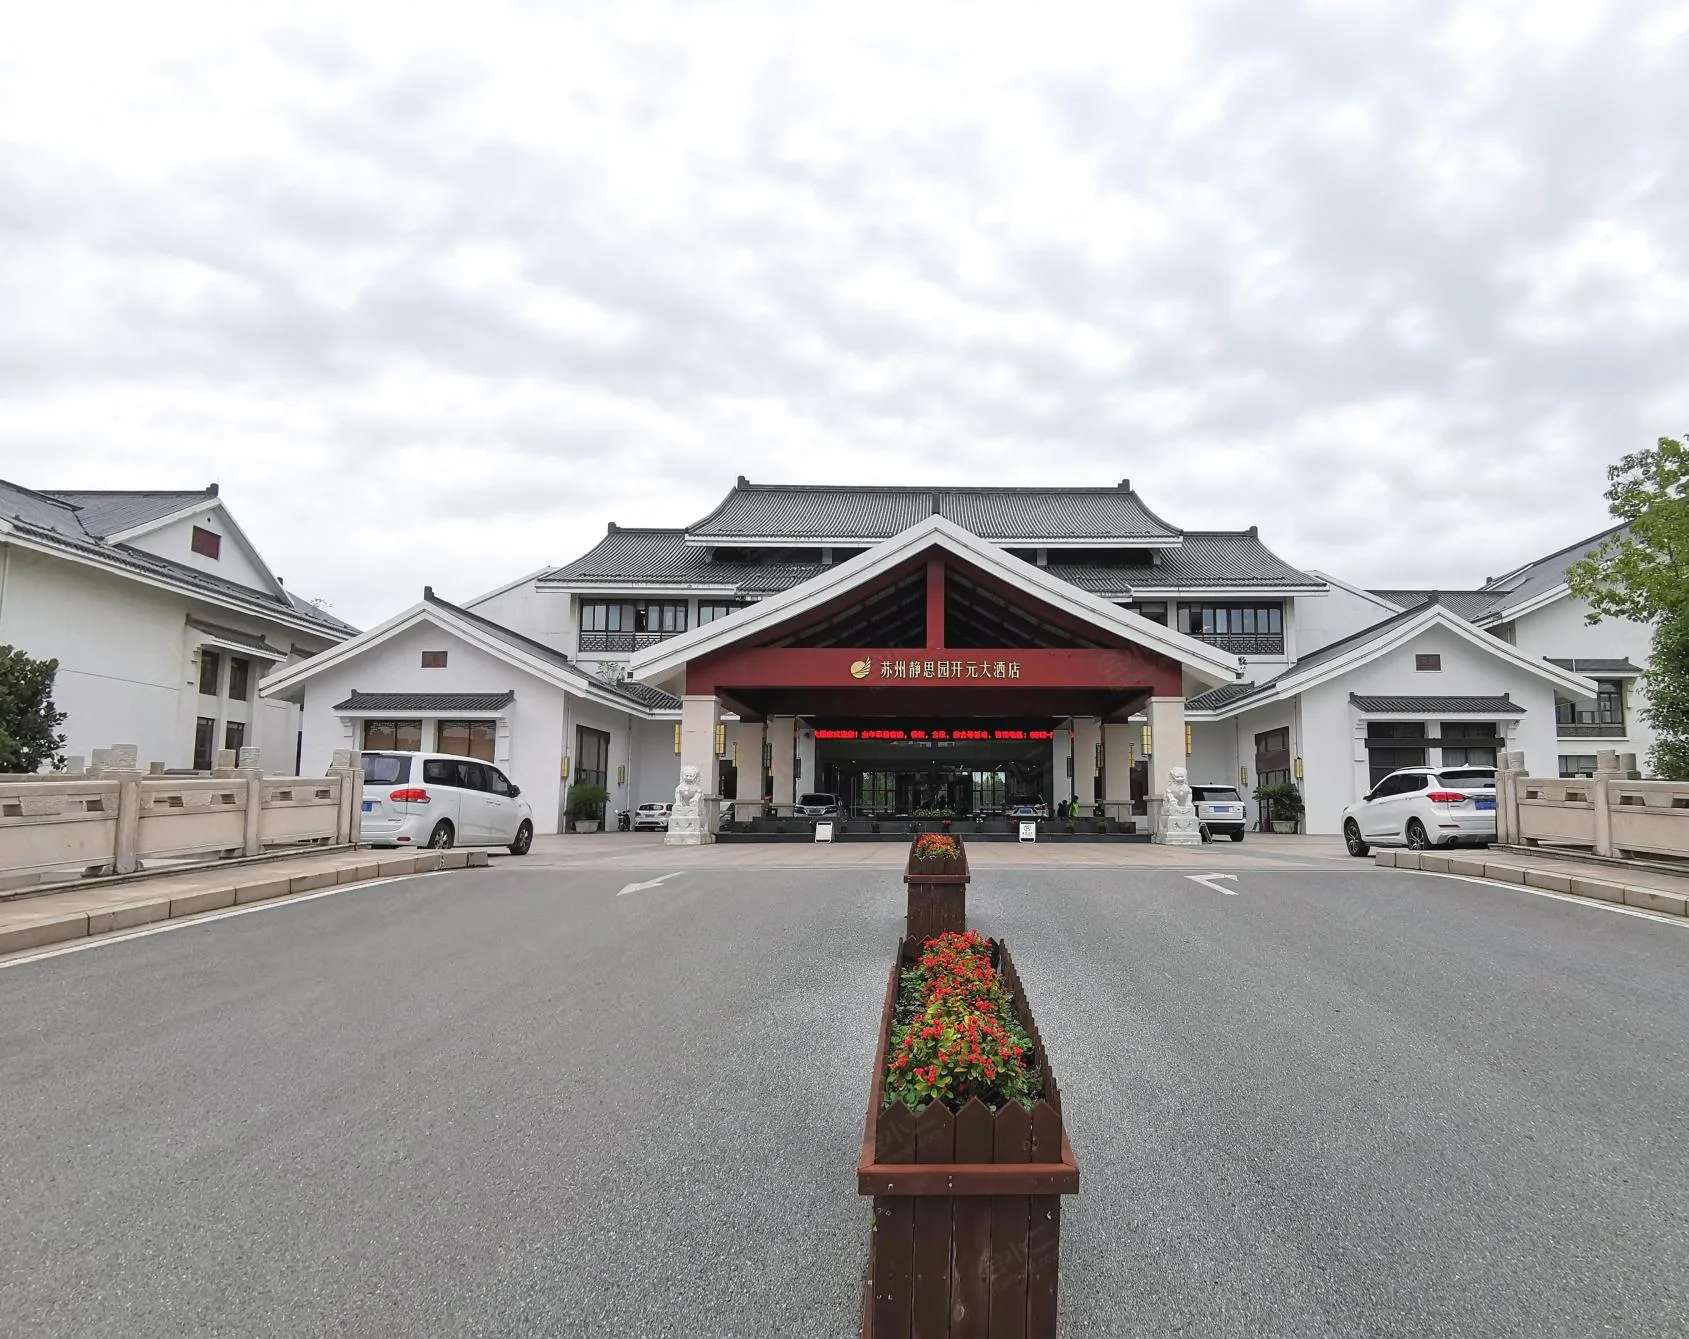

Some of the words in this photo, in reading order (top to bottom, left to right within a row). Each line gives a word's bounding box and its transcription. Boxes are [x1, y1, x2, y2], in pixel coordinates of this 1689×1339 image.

[880, 660, 1021, 679] 苏州静思园开元大酒店
